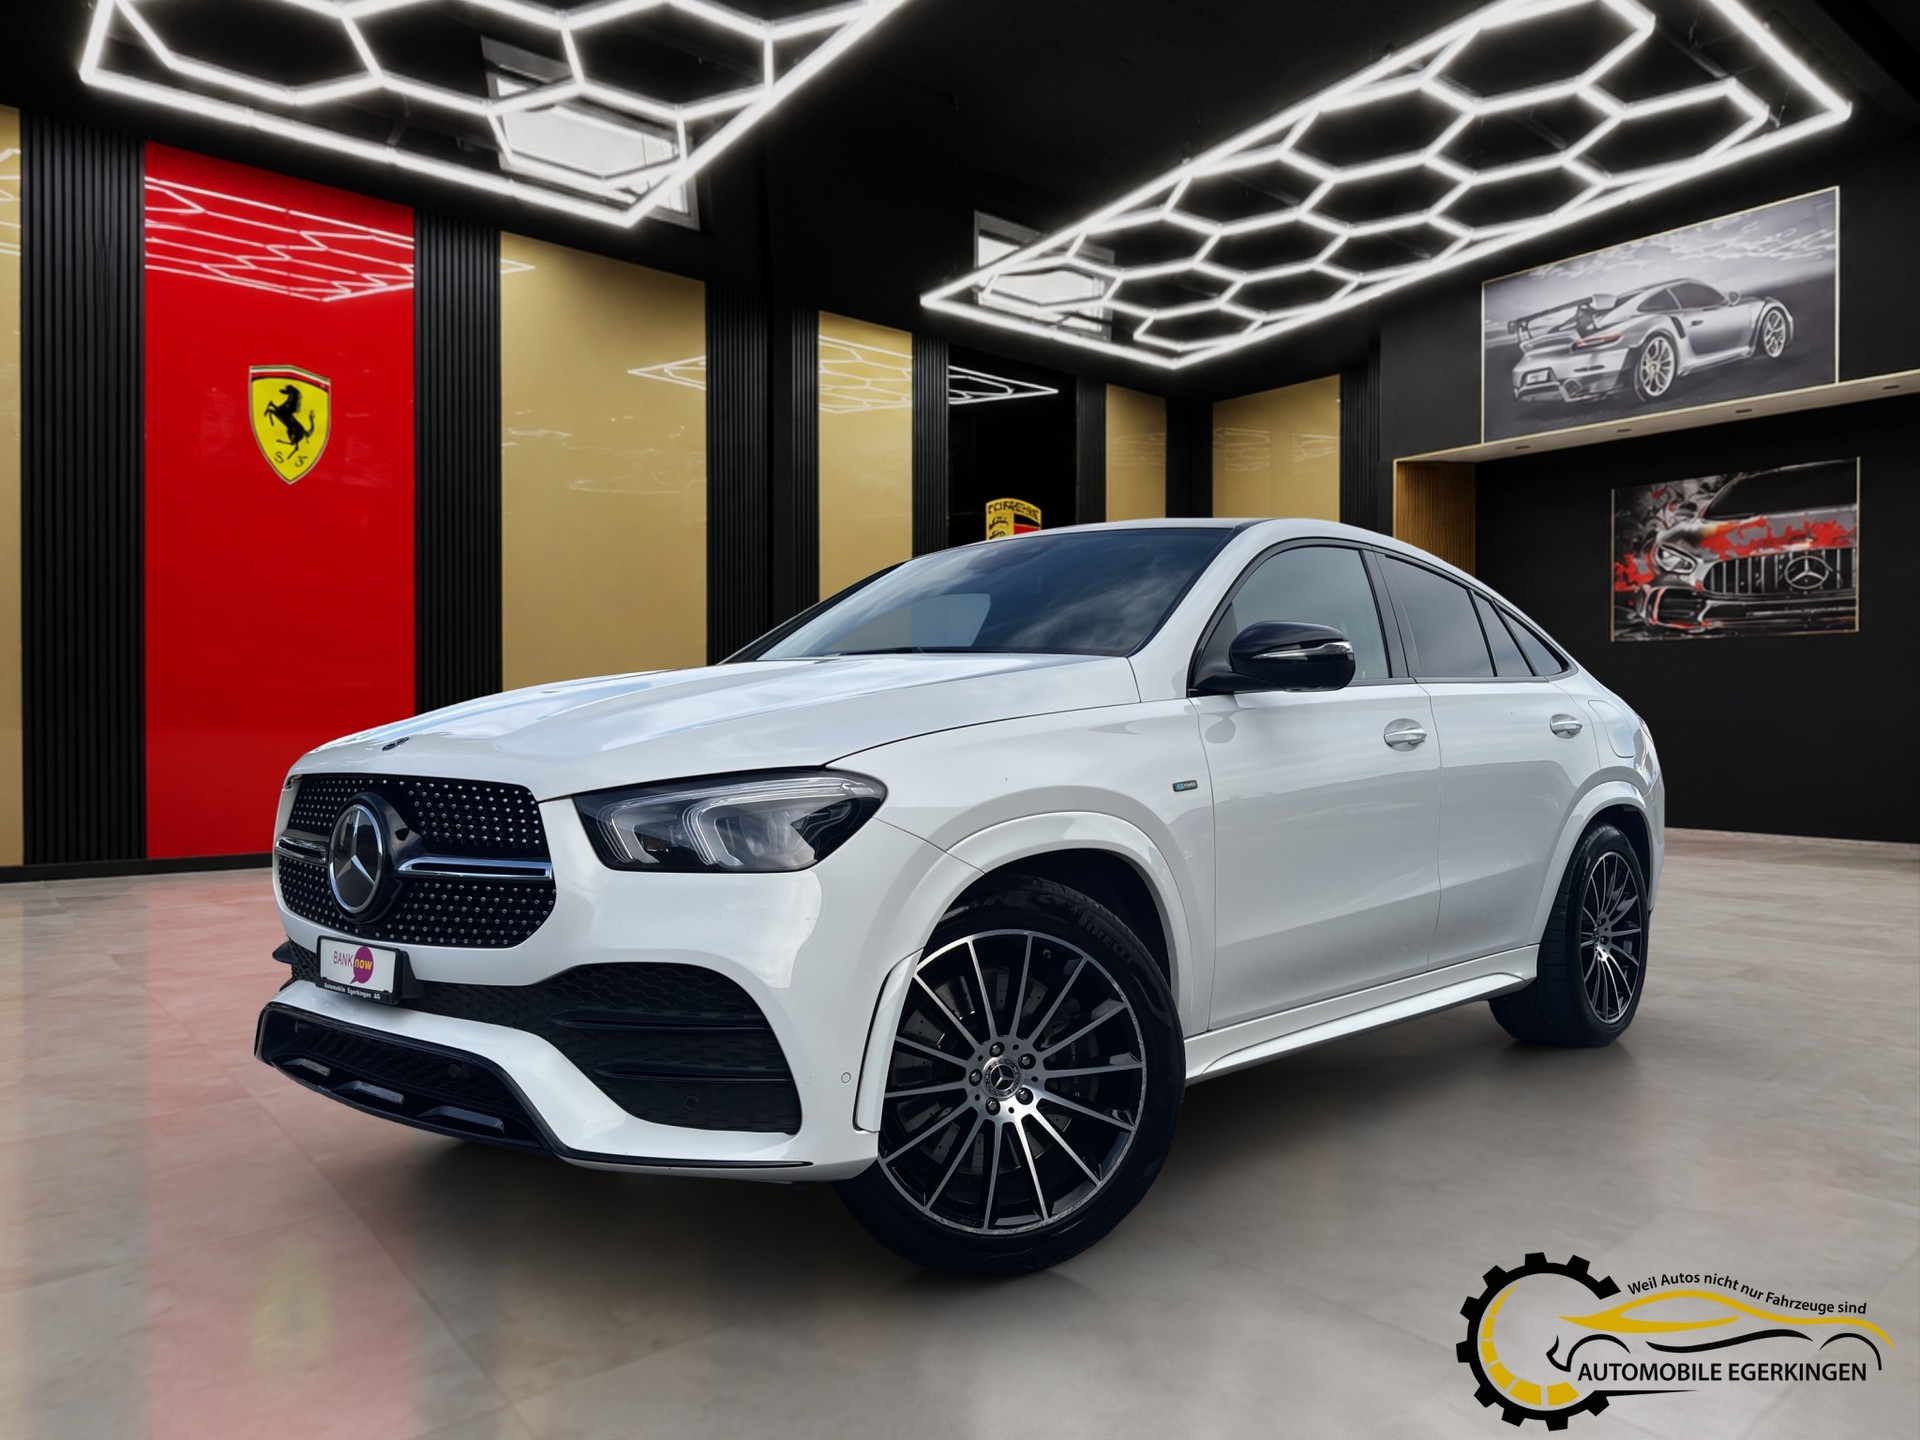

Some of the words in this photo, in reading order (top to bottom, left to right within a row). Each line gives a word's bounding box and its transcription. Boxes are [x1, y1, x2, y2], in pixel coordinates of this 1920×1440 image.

[333, 950, 354, 967] BANK
[354, 959, 372, 971] now
[324, 982, 345, 992] Automobile
[347, 987, 372, 998] Egerkingen
